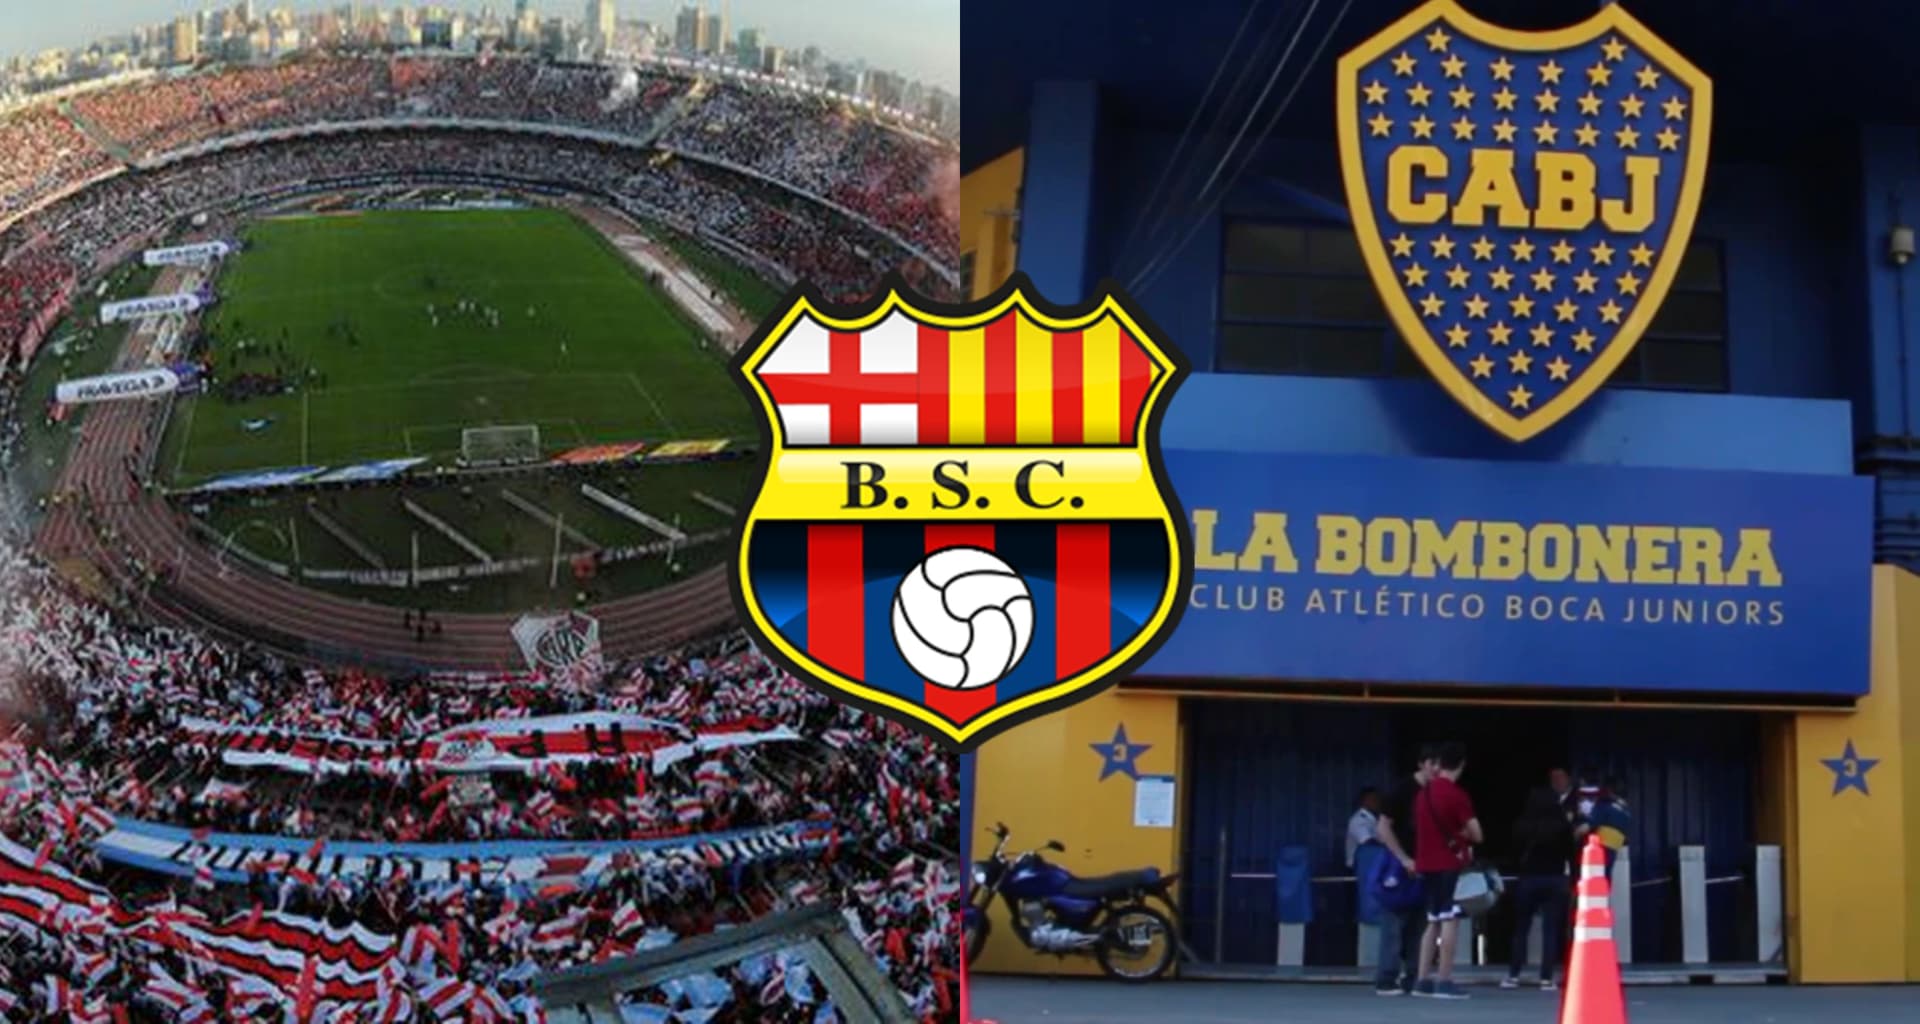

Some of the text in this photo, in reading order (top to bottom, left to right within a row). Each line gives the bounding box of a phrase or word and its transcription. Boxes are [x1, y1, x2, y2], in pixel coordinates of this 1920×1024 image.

[1387, 144, 1660, 233] CABJ
[1192, 509, 1783, 587] LA BOMBONERA
[1190, 584, 1784, 625] CLUB ATLÉTICO BOCA JUNIORS
[1113, 744, 1127, 762] 3
[1843, 759, 1857, 777] 3
